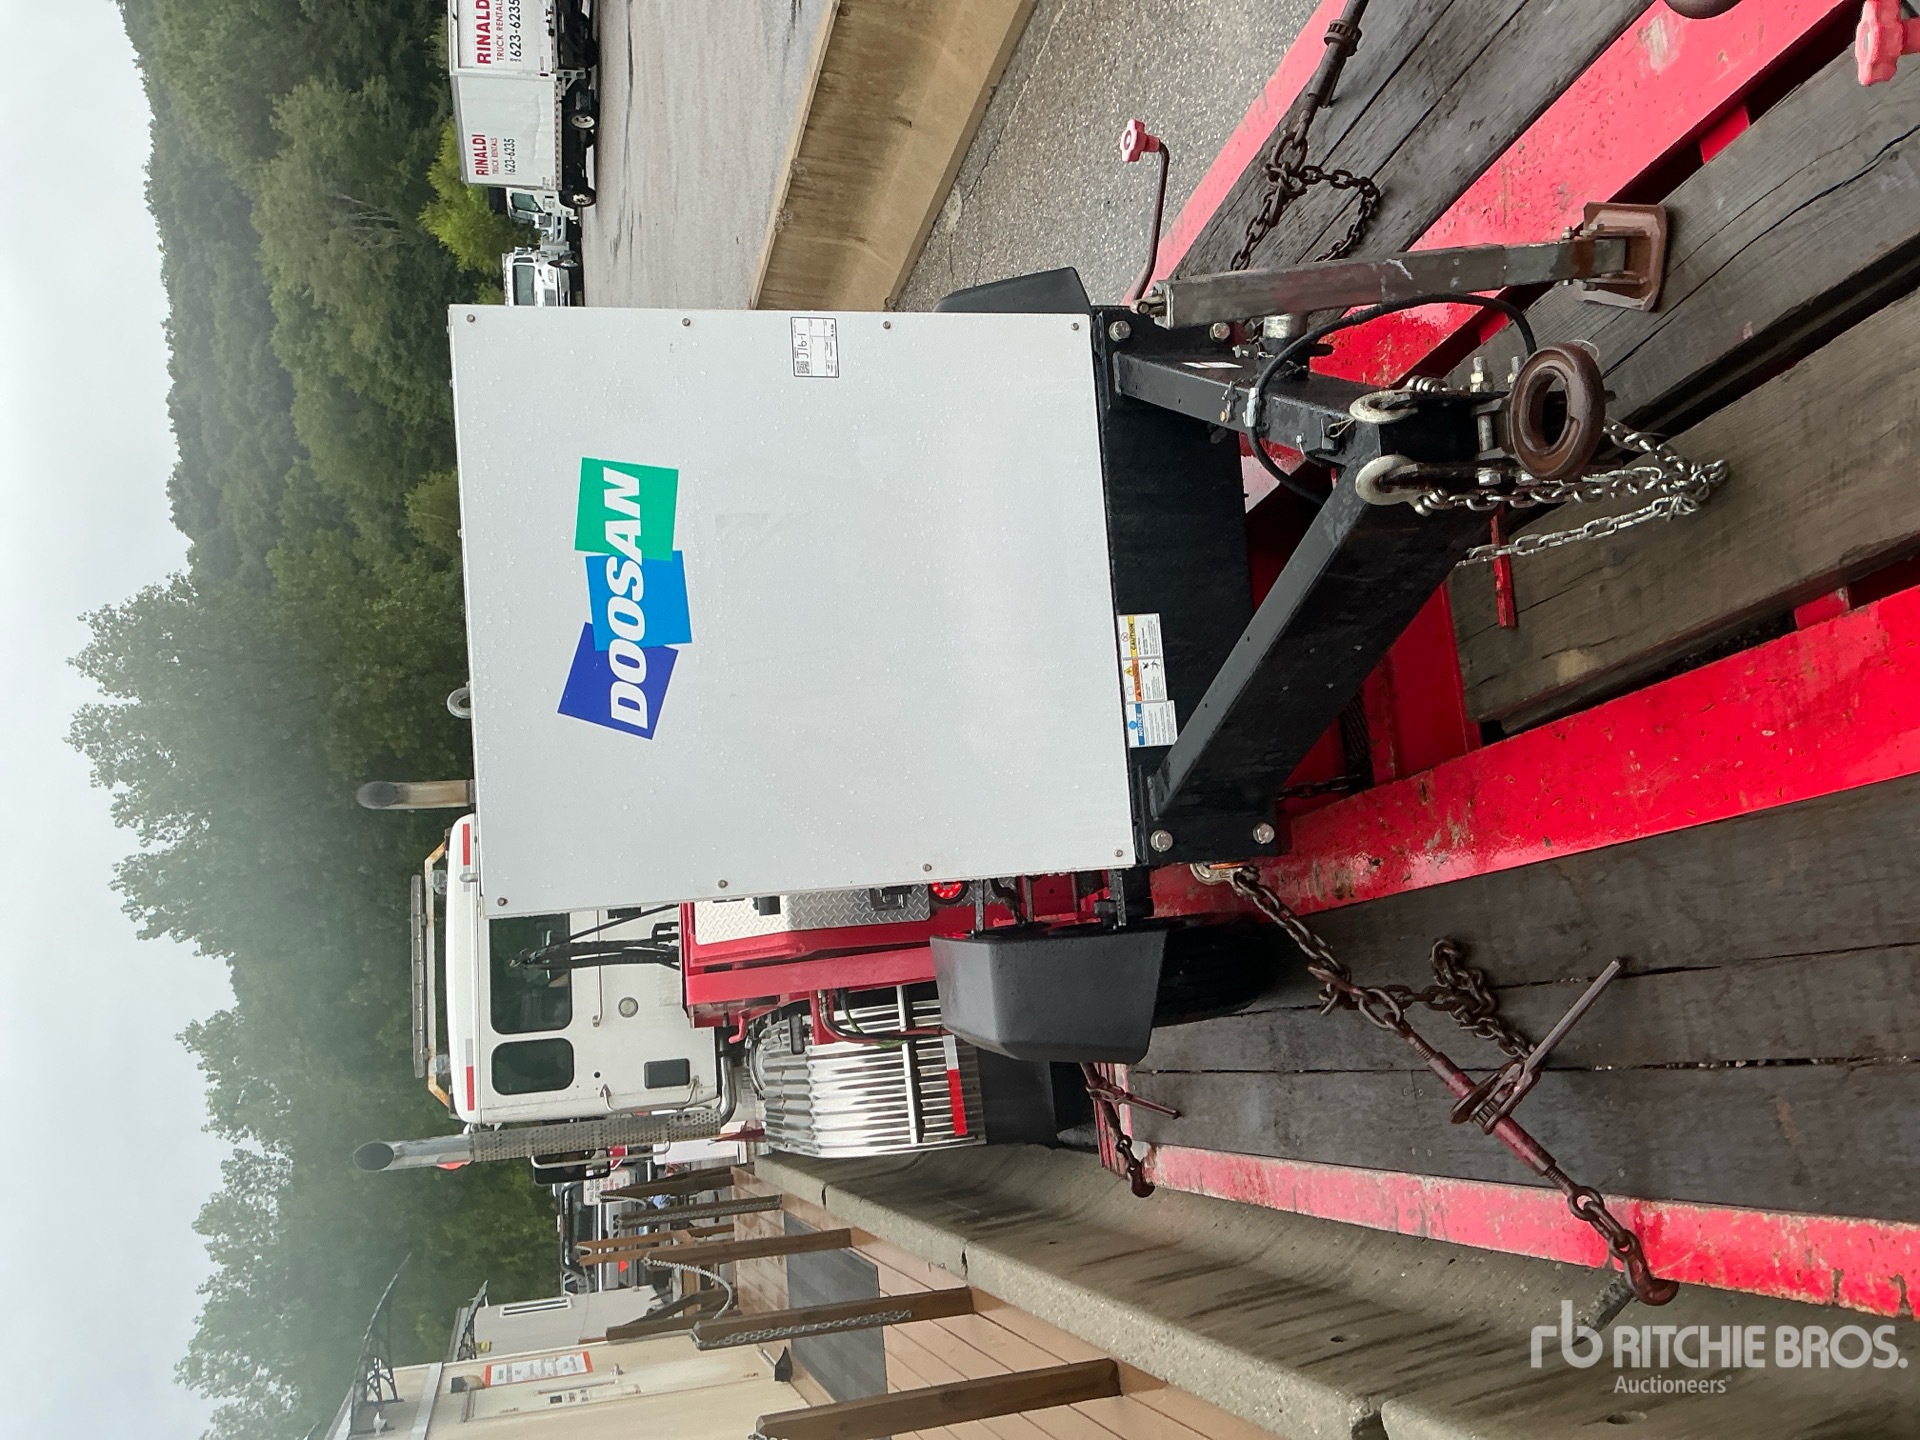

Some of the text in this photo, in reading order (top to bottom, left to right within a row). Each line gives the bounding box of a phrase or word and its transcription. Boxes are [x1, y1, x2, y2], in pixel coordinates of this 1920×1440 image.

[476, 0, 491, 64] RINALD
[496, 34, 504, 61] TRUCK
[508, 0, 521, 57] 623-6235
[471, 134, 489, 176] RINALDI
[503, 138, 516, 173] 623-6235
[602, 466, 648, 730] DOOSAN
[1136, 712, 1144, 737] NOTICE
